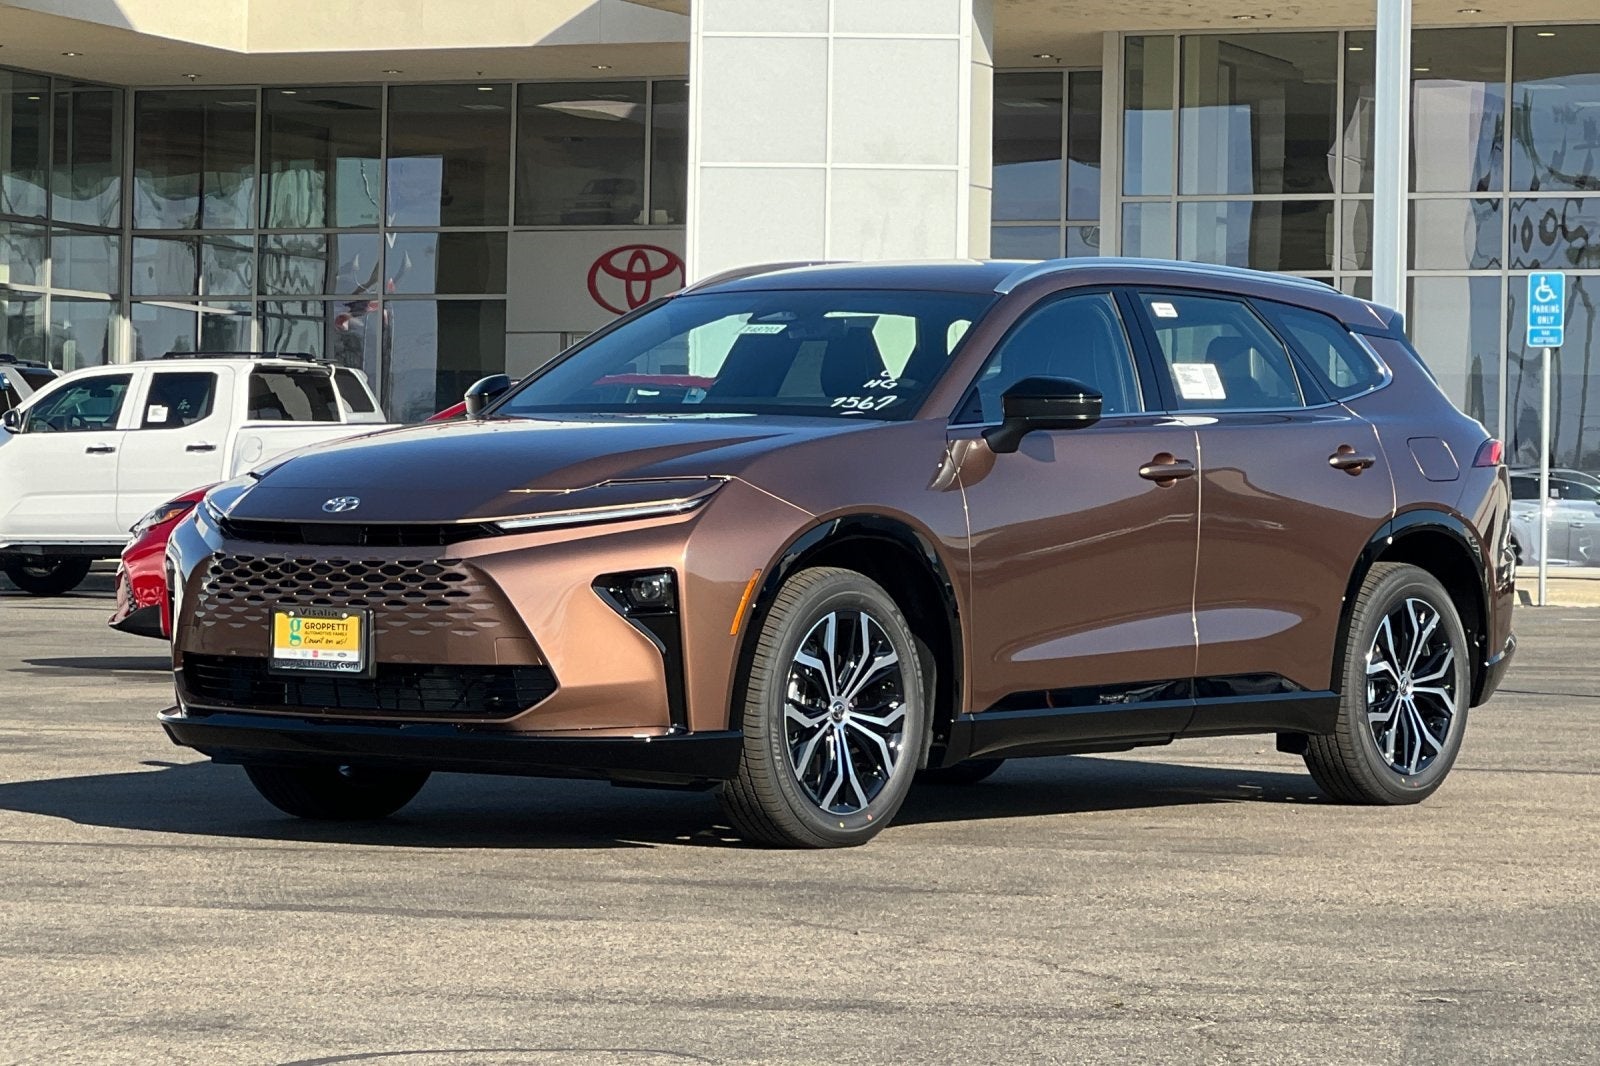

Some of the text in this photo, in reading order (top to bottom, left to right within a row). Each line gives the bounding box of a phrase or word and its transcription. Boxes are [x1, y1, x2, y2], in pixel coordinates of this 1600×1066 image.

[1532, 305, 1560, 314] PARKING
[1537, 316, 1555, 325] ONLY
[304, 622, 348, 631] GROPPETTI
[304, 637, 323, 645] Count
